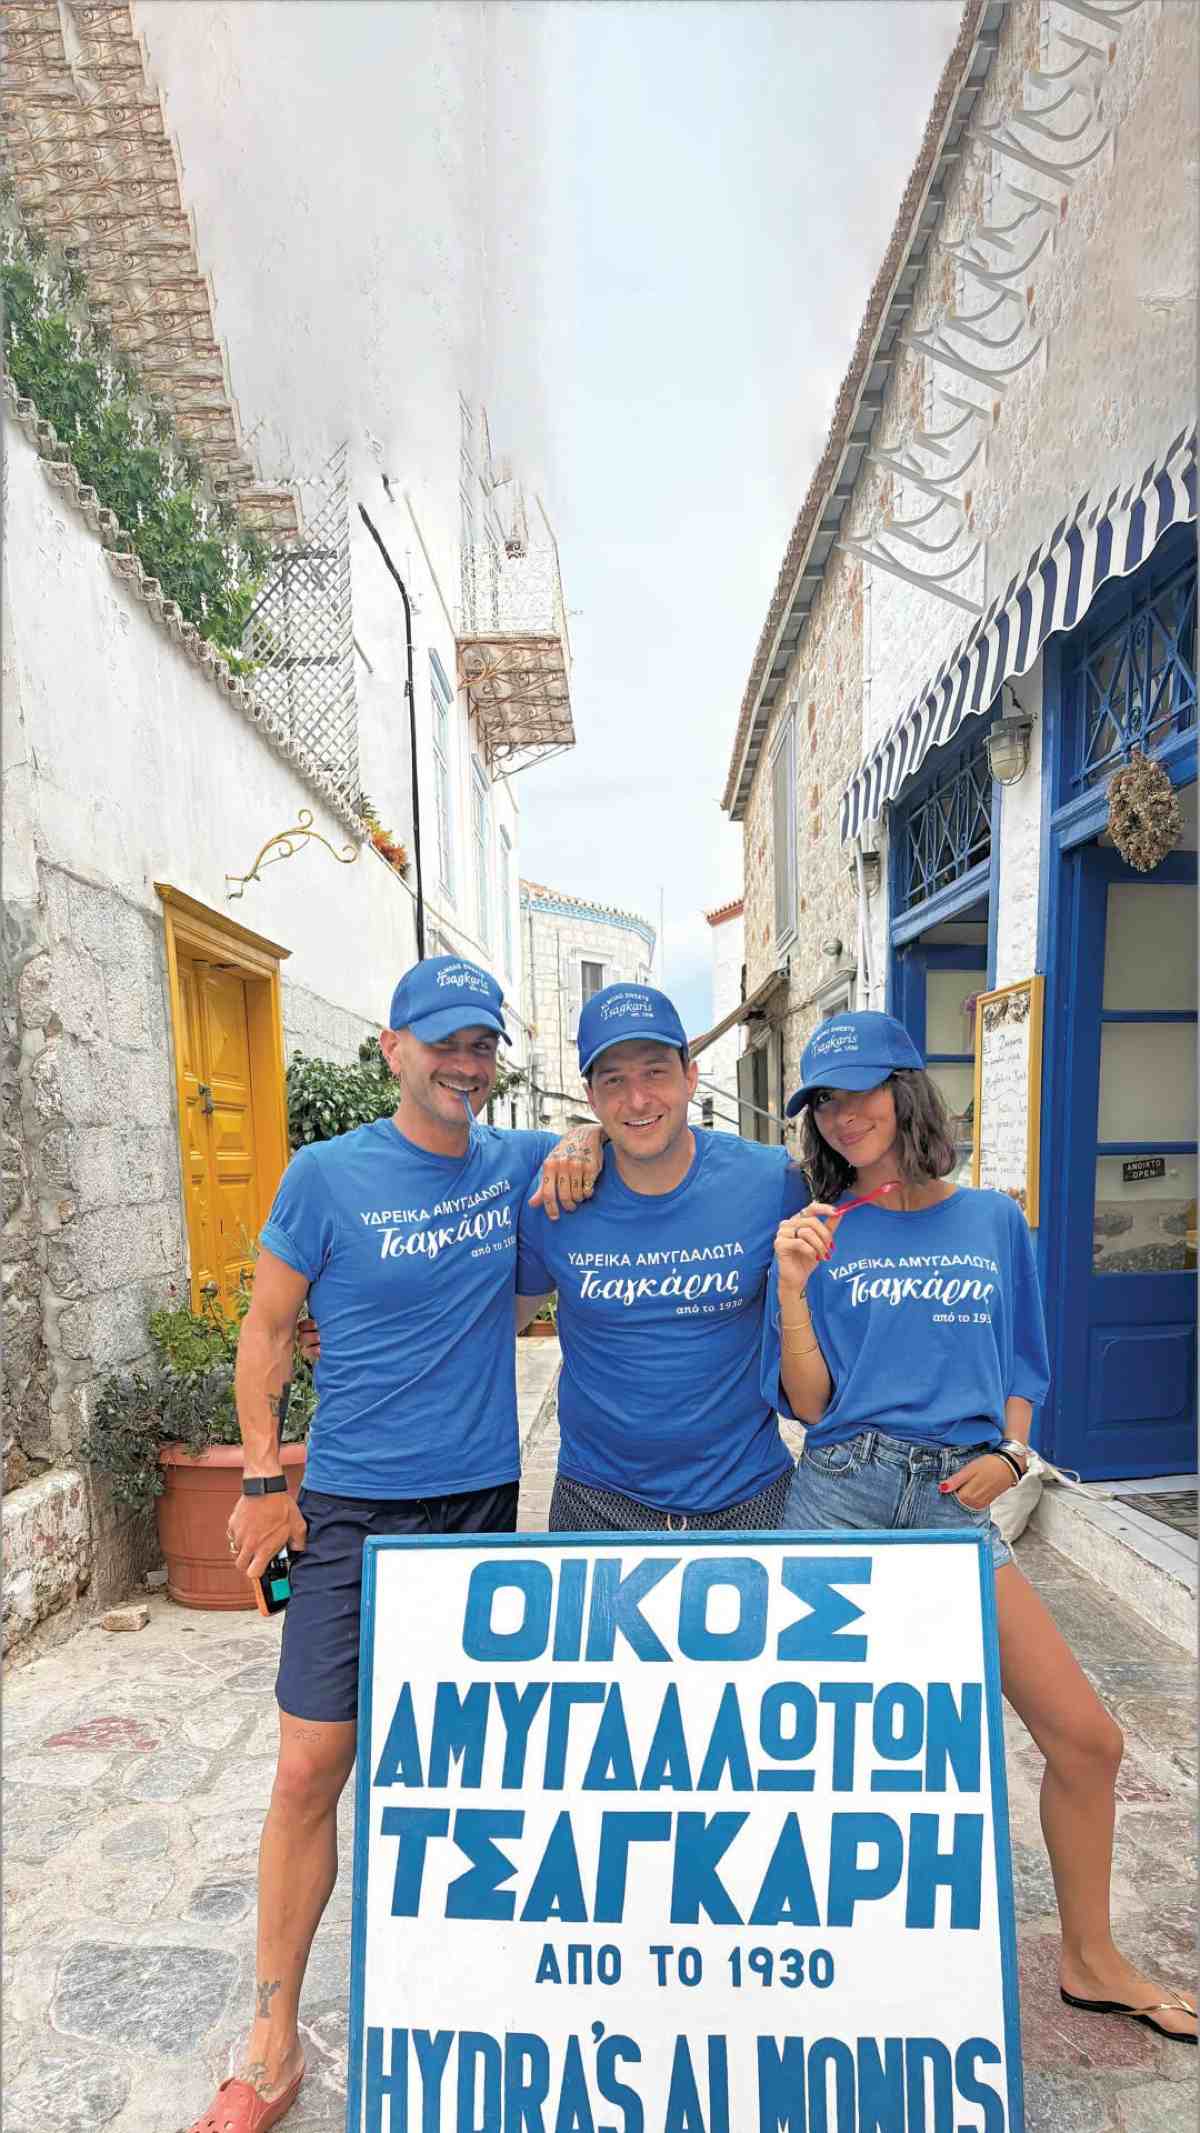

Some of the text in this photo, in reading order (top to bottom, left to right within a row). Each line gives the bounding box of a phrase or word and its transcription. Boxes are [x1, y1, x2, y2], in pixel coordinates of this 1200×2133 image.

[360, 1209, 430, 1226] ΥΔΡΕΙΚΑ
[568, 1242, 744, 1267] ΥΔΡΕΙΚΑ ΑΜΥΓΔΑΛΩΤΑ
[829, 1254, 999, 1280] ΥΔΡΕΙΚΑ ΑΜΥΓΔΑΛΩΤΑ
[579, 1268, 740, 1306] Τσαγκάρης
[676, 1303, 699, 1314] από
[703, 1305, 715, 1313] το
[932, 1312, 955, 1323] από
[461, 1557, 873, 1662] ΟΙΚΟΣ
[373, 1681, 982, 1793] ΑΜΥΓΔΑΛΩΤΩΝ
[380, 1806, 984, 1930] ΤΣΑΓΚΑΡΗ
[535, 1943, 835, 1989] ΑΠΟ ΤΟ 1930
